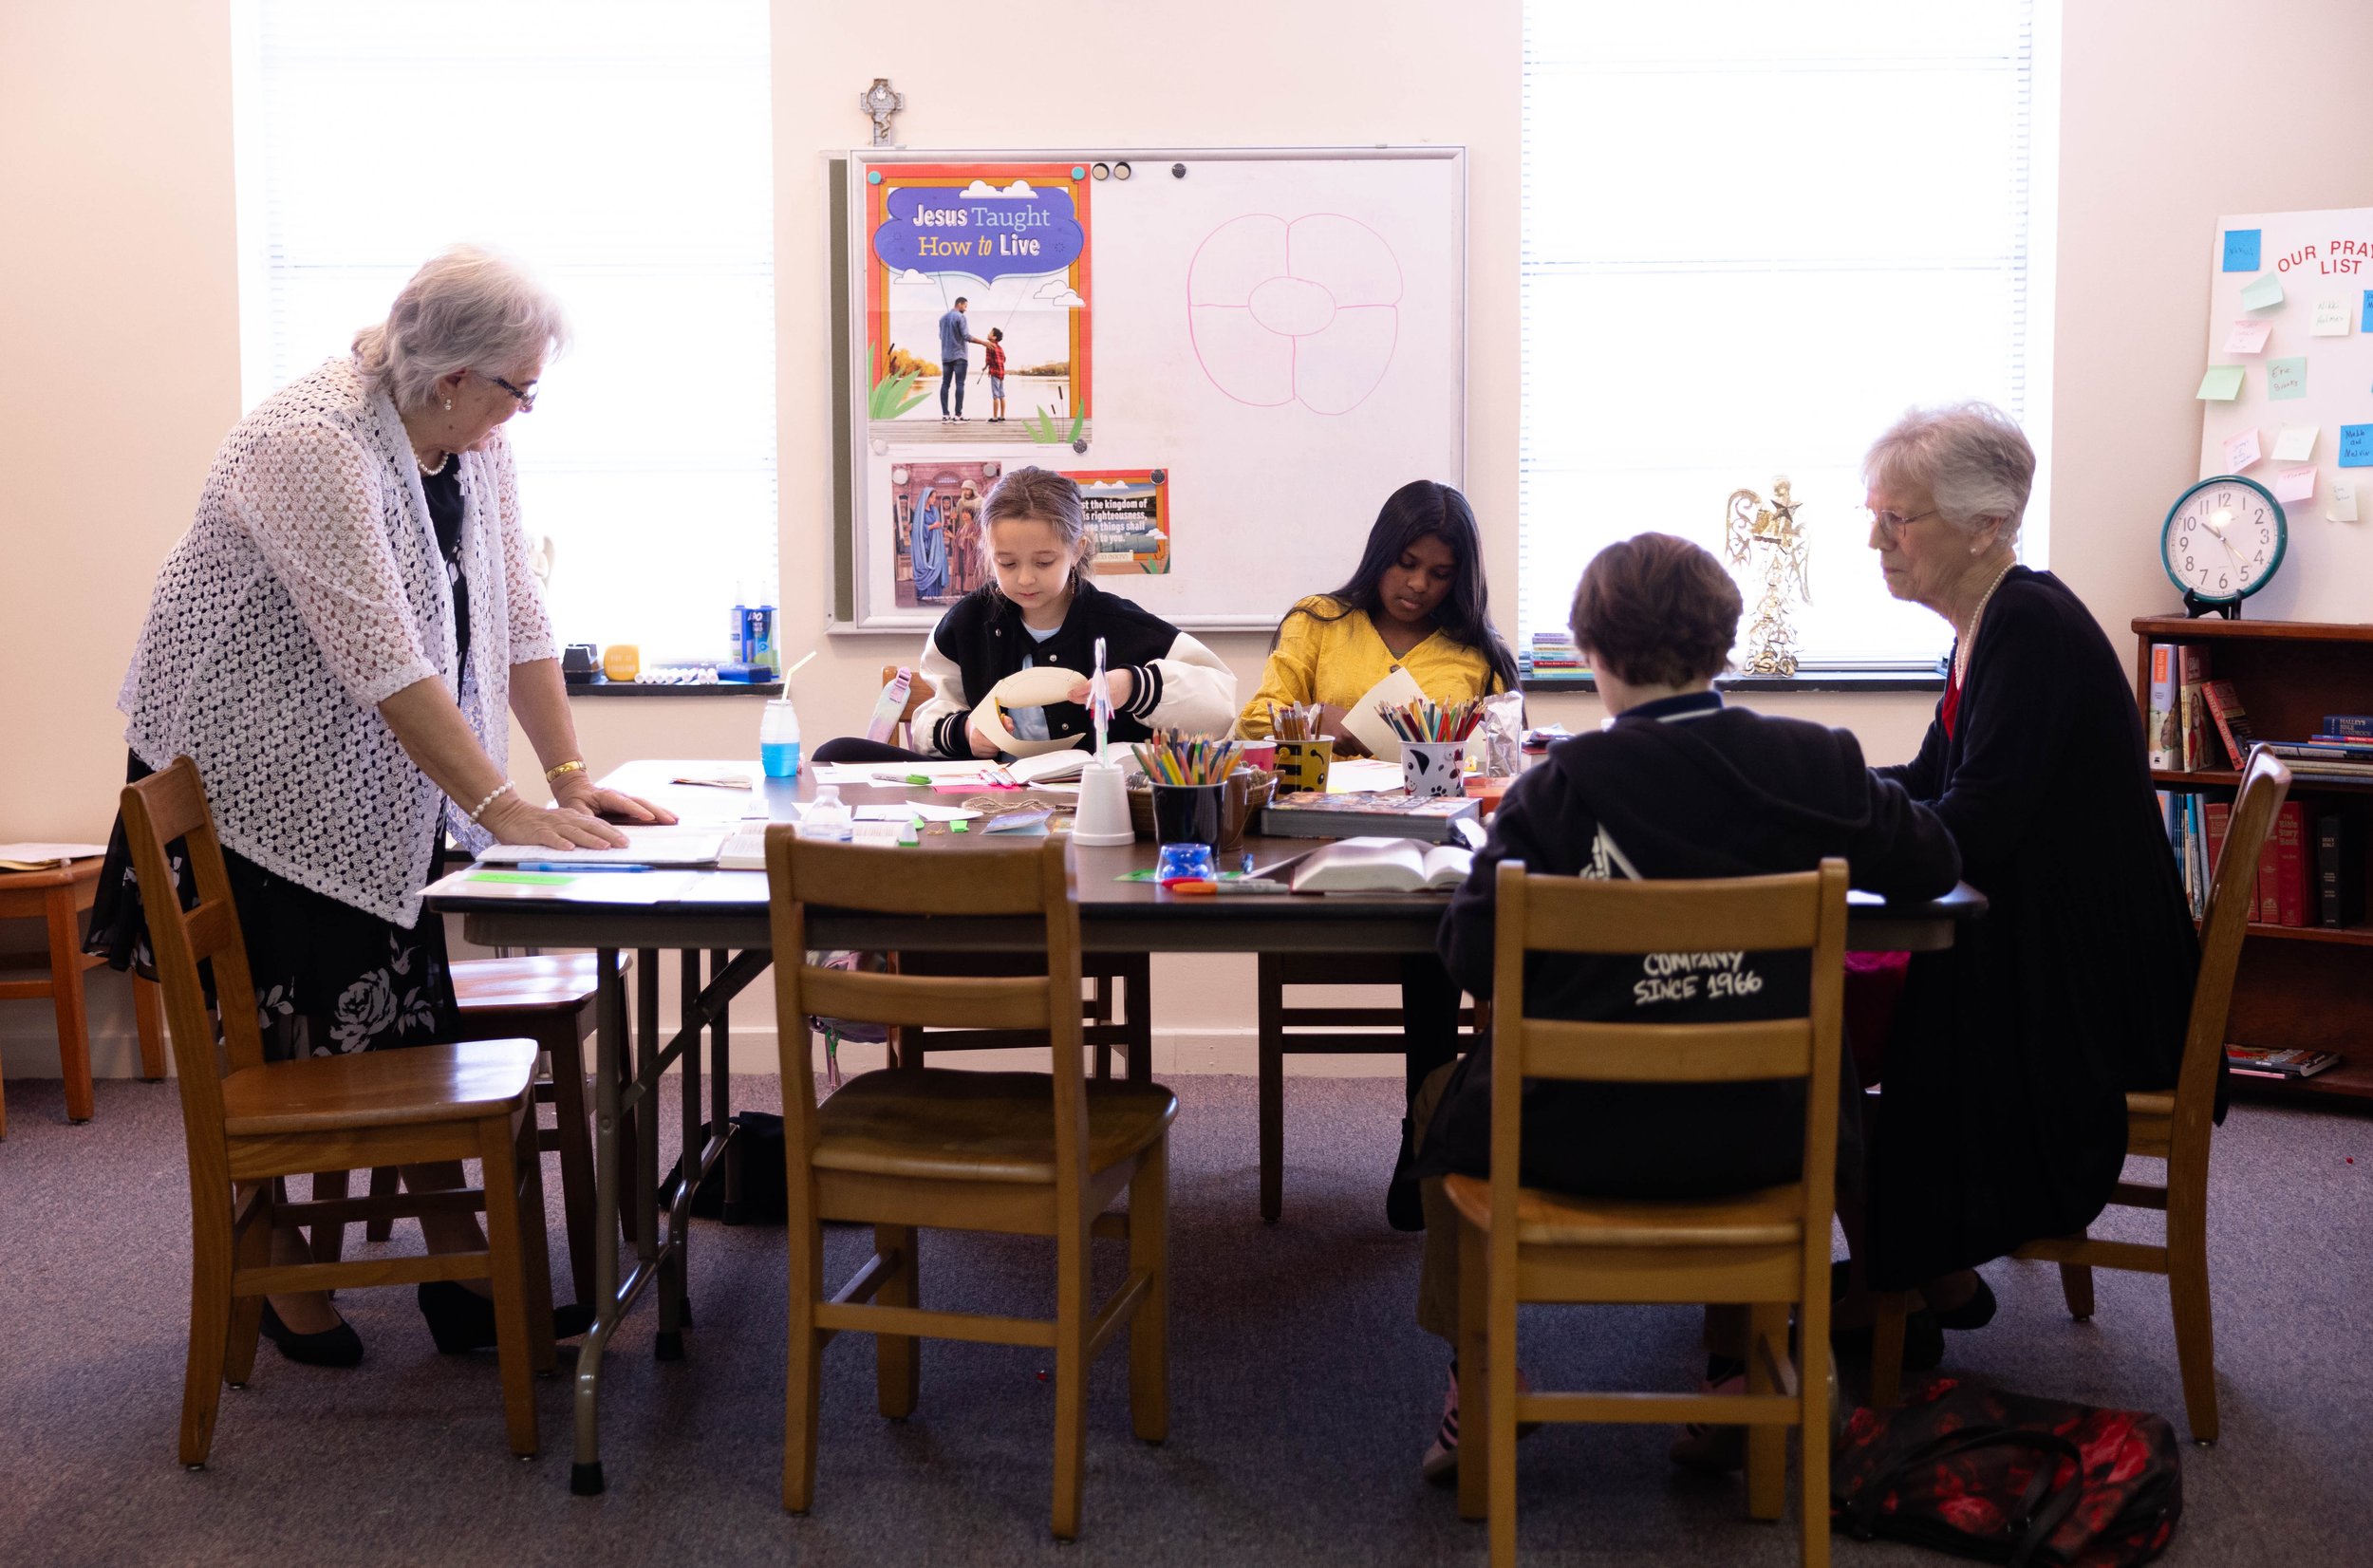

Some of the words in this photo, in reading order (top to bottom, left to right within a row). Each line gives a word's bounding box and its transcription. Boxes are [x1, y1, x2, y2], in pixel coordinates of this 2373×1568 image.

[912, 203, 968, 227] Jesus
[971, 204, 1051, 232] Taught
[918, 236, 972, 256] How
[978, 234, 993, 256] to
[1000, 233, 1041, 256] Live
[2278, 245, 2316, 272] OUR
[2321, 258, 2362, 274] LIST
[1091, 499, 1104, 510] the
[1105, 499, 1137, 511] kingdom
[1139, 498, 1148, 509] of
[2199, 500, 2209, 515] 11
[2217, 493, 2232, 508] 12
[2242, 496, 2246, 511] 1
[1091, 511, 1148, 523] righteousness,
[2183, 516, 2196, 532] 10
[2254, 508, 2264, 525] 2
[1100, 522, 1125, 533] things
[1126, 520, 1146, 532] shall
[1100, 533, 1108, 543] to
[2179, 536, 2189, 552] 9
[2260, 529, 2270, 545] 3
[2185, 555, 2195, 571] 8
[2253, 549, 2264, 565] 4
[2199, 569, 2209, 585] 7
[2218, 572, 2228, 589] 6
[2240, 566, 2250, 582] 5
[1633, 976, 1699, 1005] SINCE
[1707, 970, 1763, 999] 1966
